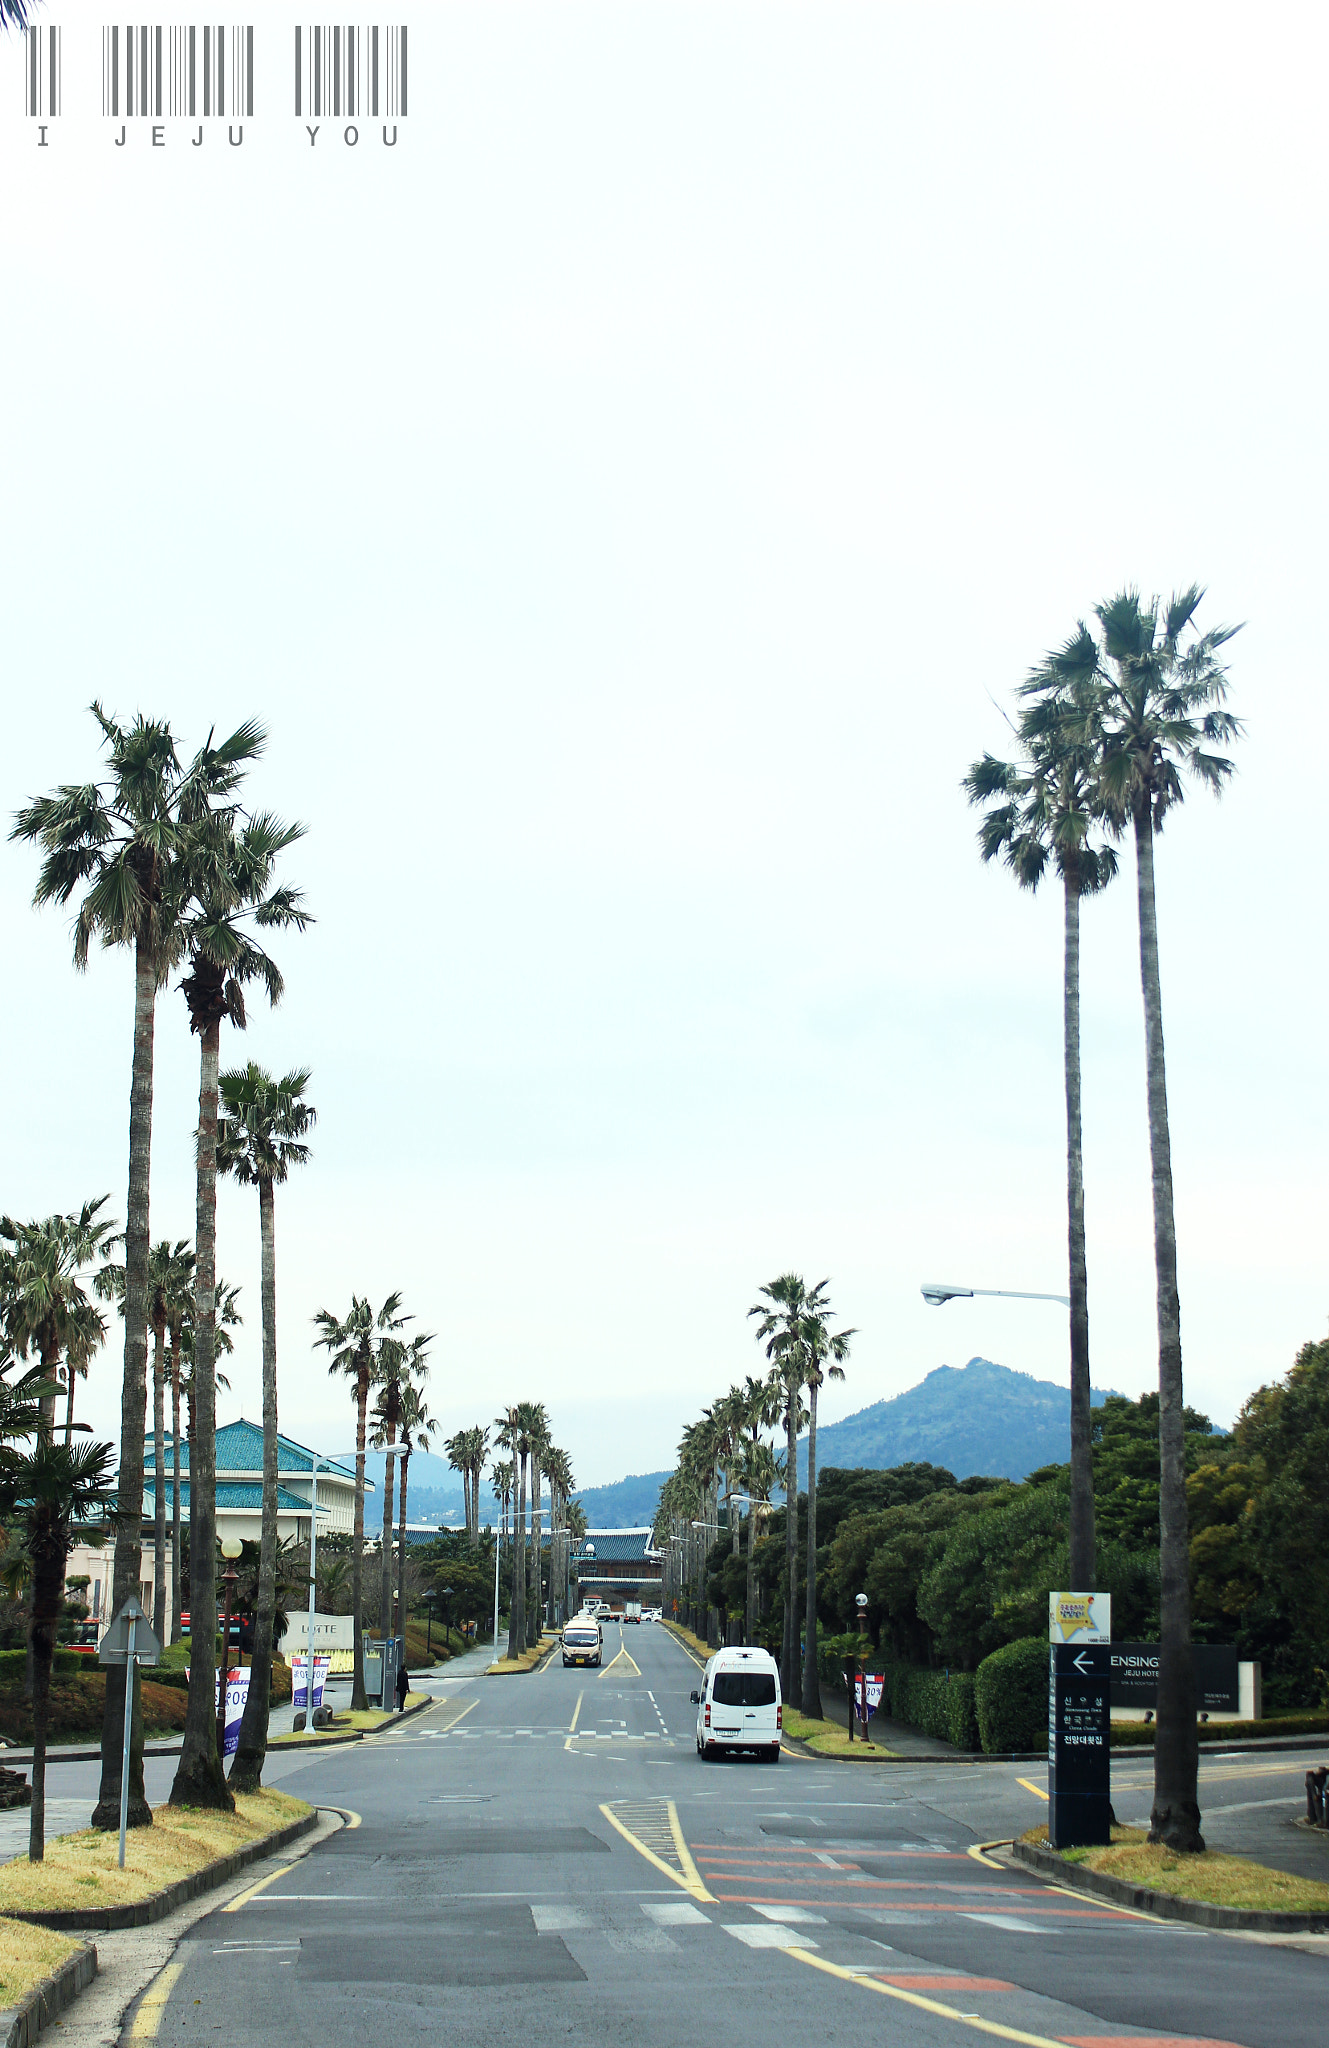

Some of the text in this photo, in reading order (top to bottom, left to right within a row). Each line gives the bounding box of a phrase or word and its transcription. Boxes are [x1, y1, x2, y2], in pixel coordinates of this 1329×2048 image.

[1110, 1655, 1160, 1668] ENSING
[1123, 1669, 1140, 1677] JEJU
[867, 1687, 881, 1696] 30%
[1063, 1735, 1103, 1746] 전망대횟집
